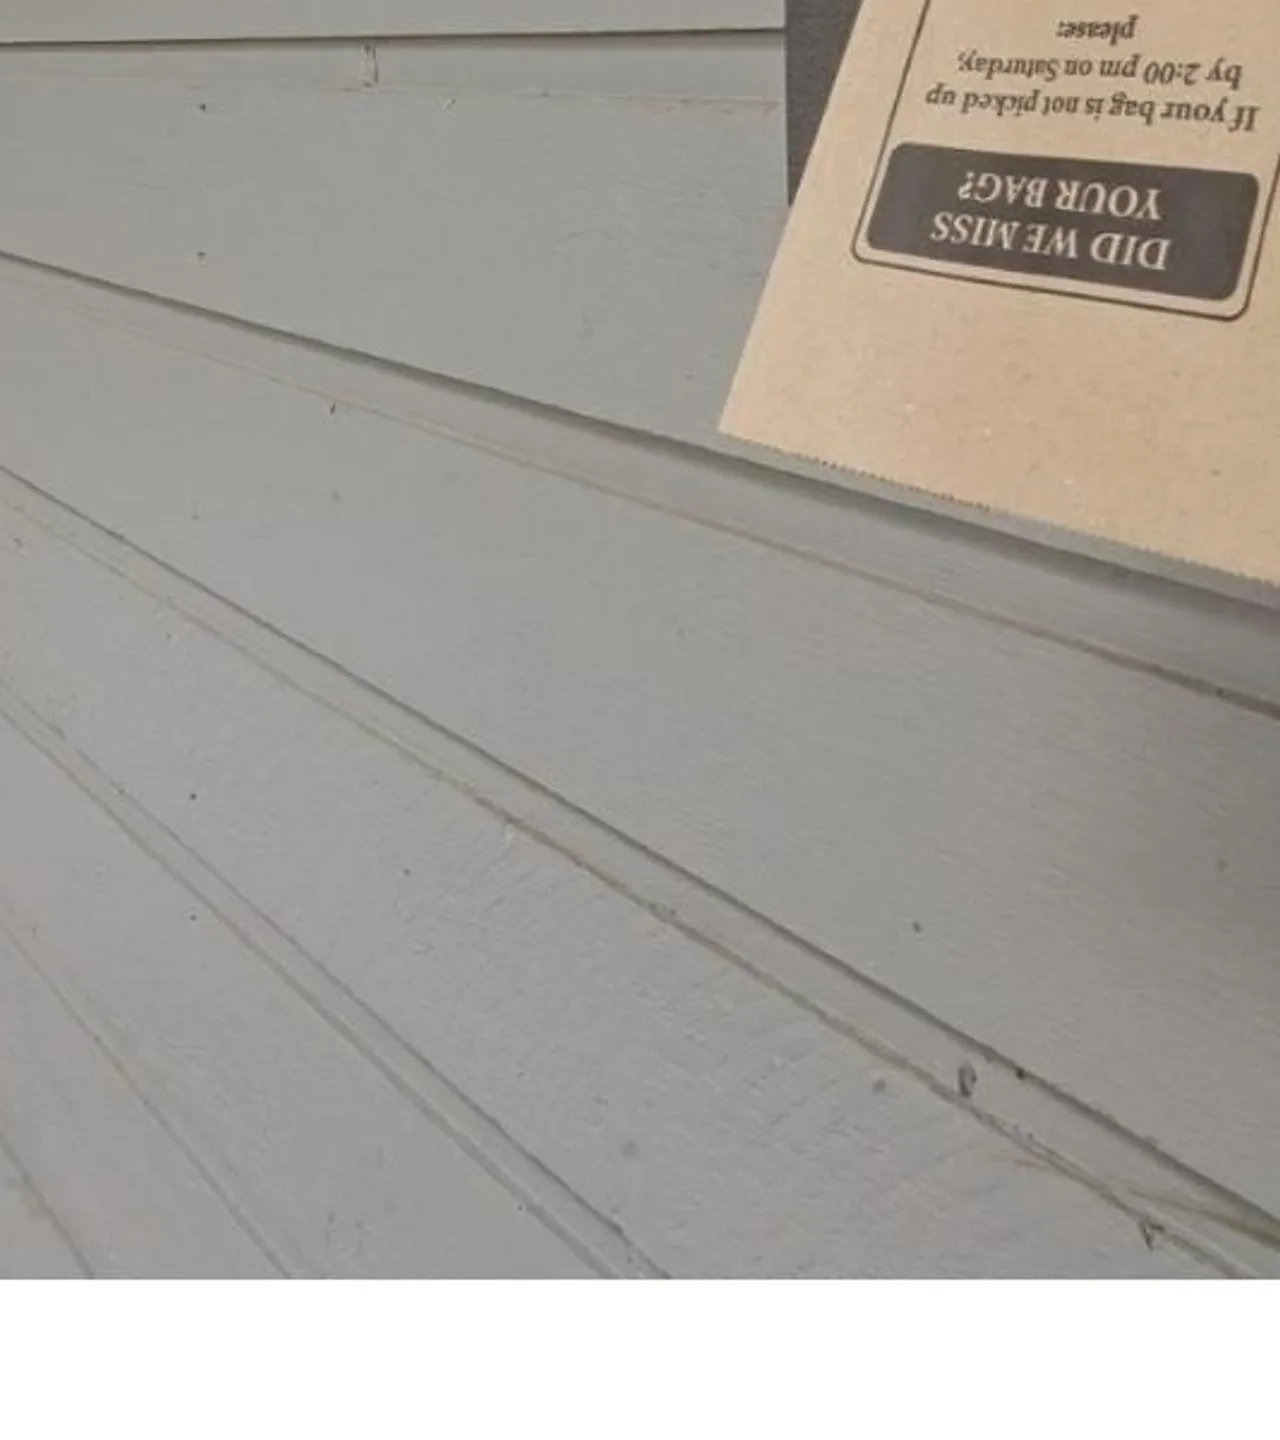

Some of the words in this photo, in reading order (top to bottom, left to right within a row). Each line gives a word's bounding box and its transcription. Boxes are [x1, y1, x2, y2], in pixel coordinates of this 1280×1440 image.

[1057, 16, 1138, 46] please:
[1065, 60, 1092, 78] on
[1099, 55, 1141, 78] pm
[1143, 62, 1200, 86] 2:00
[1207, 58, 1241, 90] by
[925, 83, 956, 107] up
[962, 90, 1039, 116] picked
[1041, 96, 1078, 116] not
[1085, 98, 1104, 121] is
[1108, 92, 1155, 125] bag
[1161, 98, 1228, 123] your
[1227, 106, 1260, 132] If
[958, 171, 1048, 208] BAG?
[1057, 179, 1162, 220] YOUR
[929, 211, 1020, 250] MISS
[1024, 223, 1079, 259] WE
[1090, 232, 1171, 271] DID
